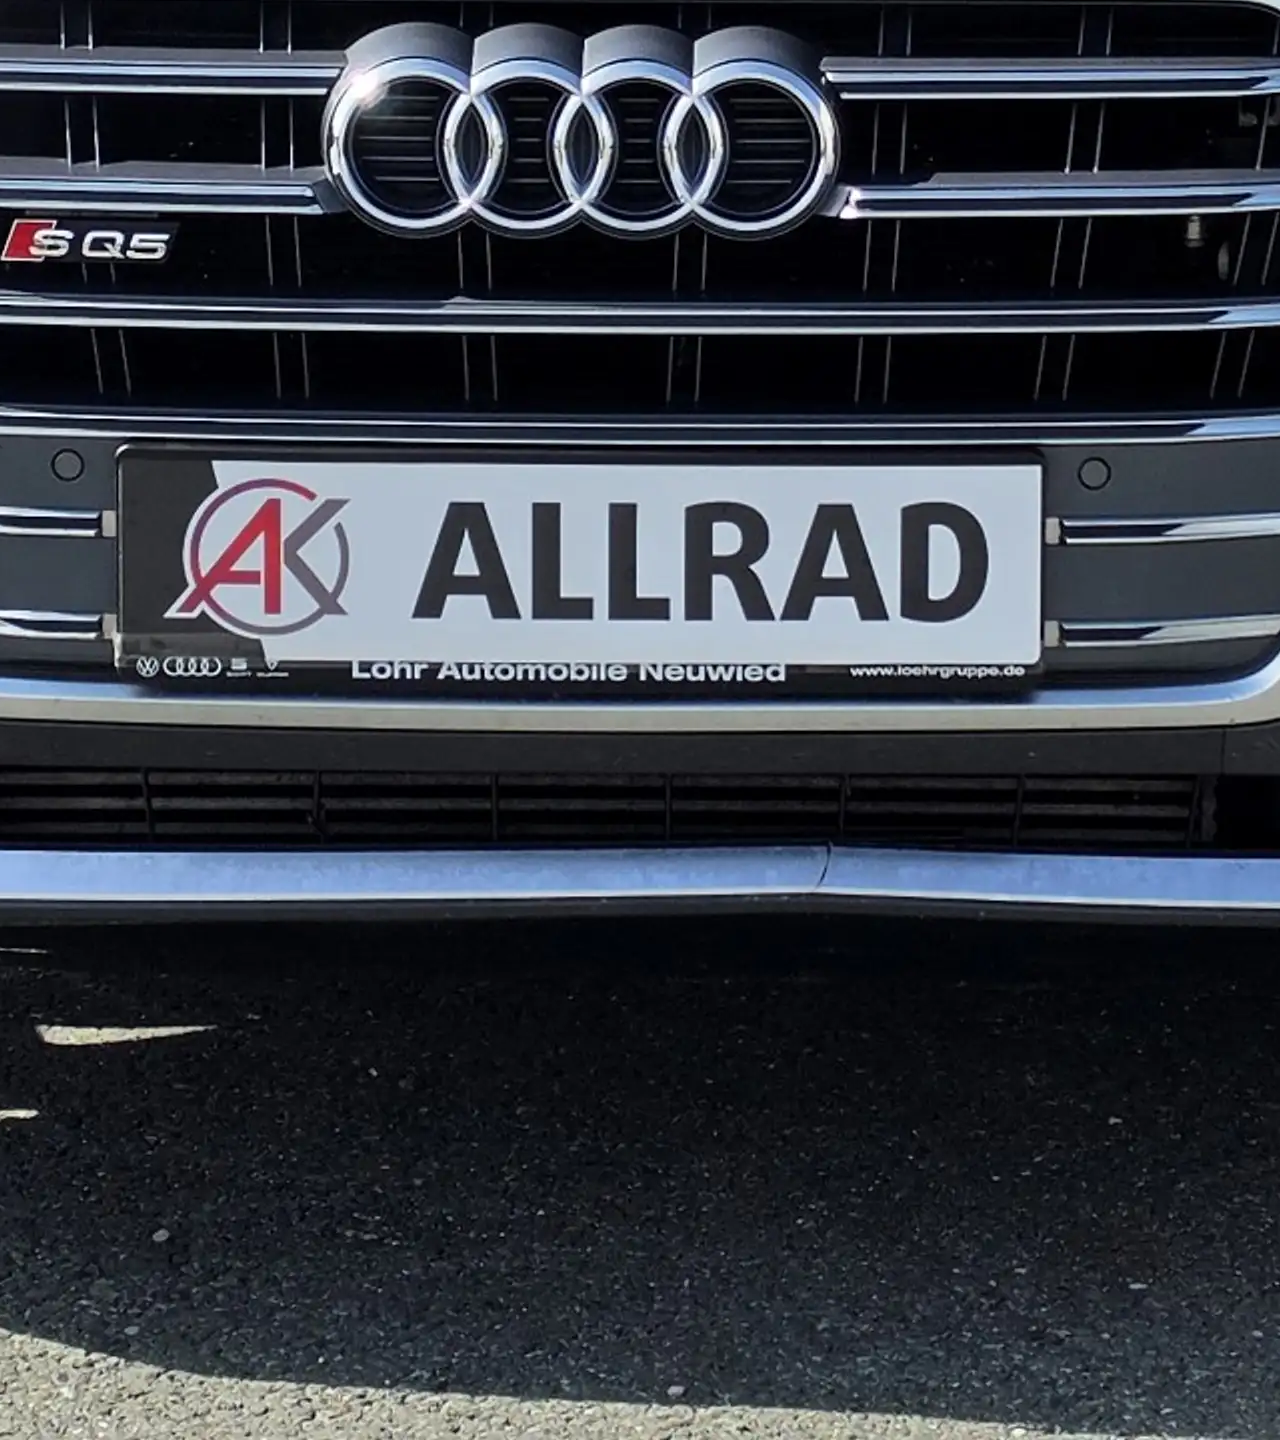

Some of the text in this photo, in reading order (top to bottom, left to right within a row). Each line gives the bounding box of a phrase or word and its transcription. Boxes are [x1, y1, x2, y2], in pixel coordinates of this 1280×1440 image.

[28, 228, 171, 260] SQ5
[410, 500, 989, 623] ALLRAD
[436, 660, 628, 681] Automobile
[638, 662, 787, 682] Neuwied
